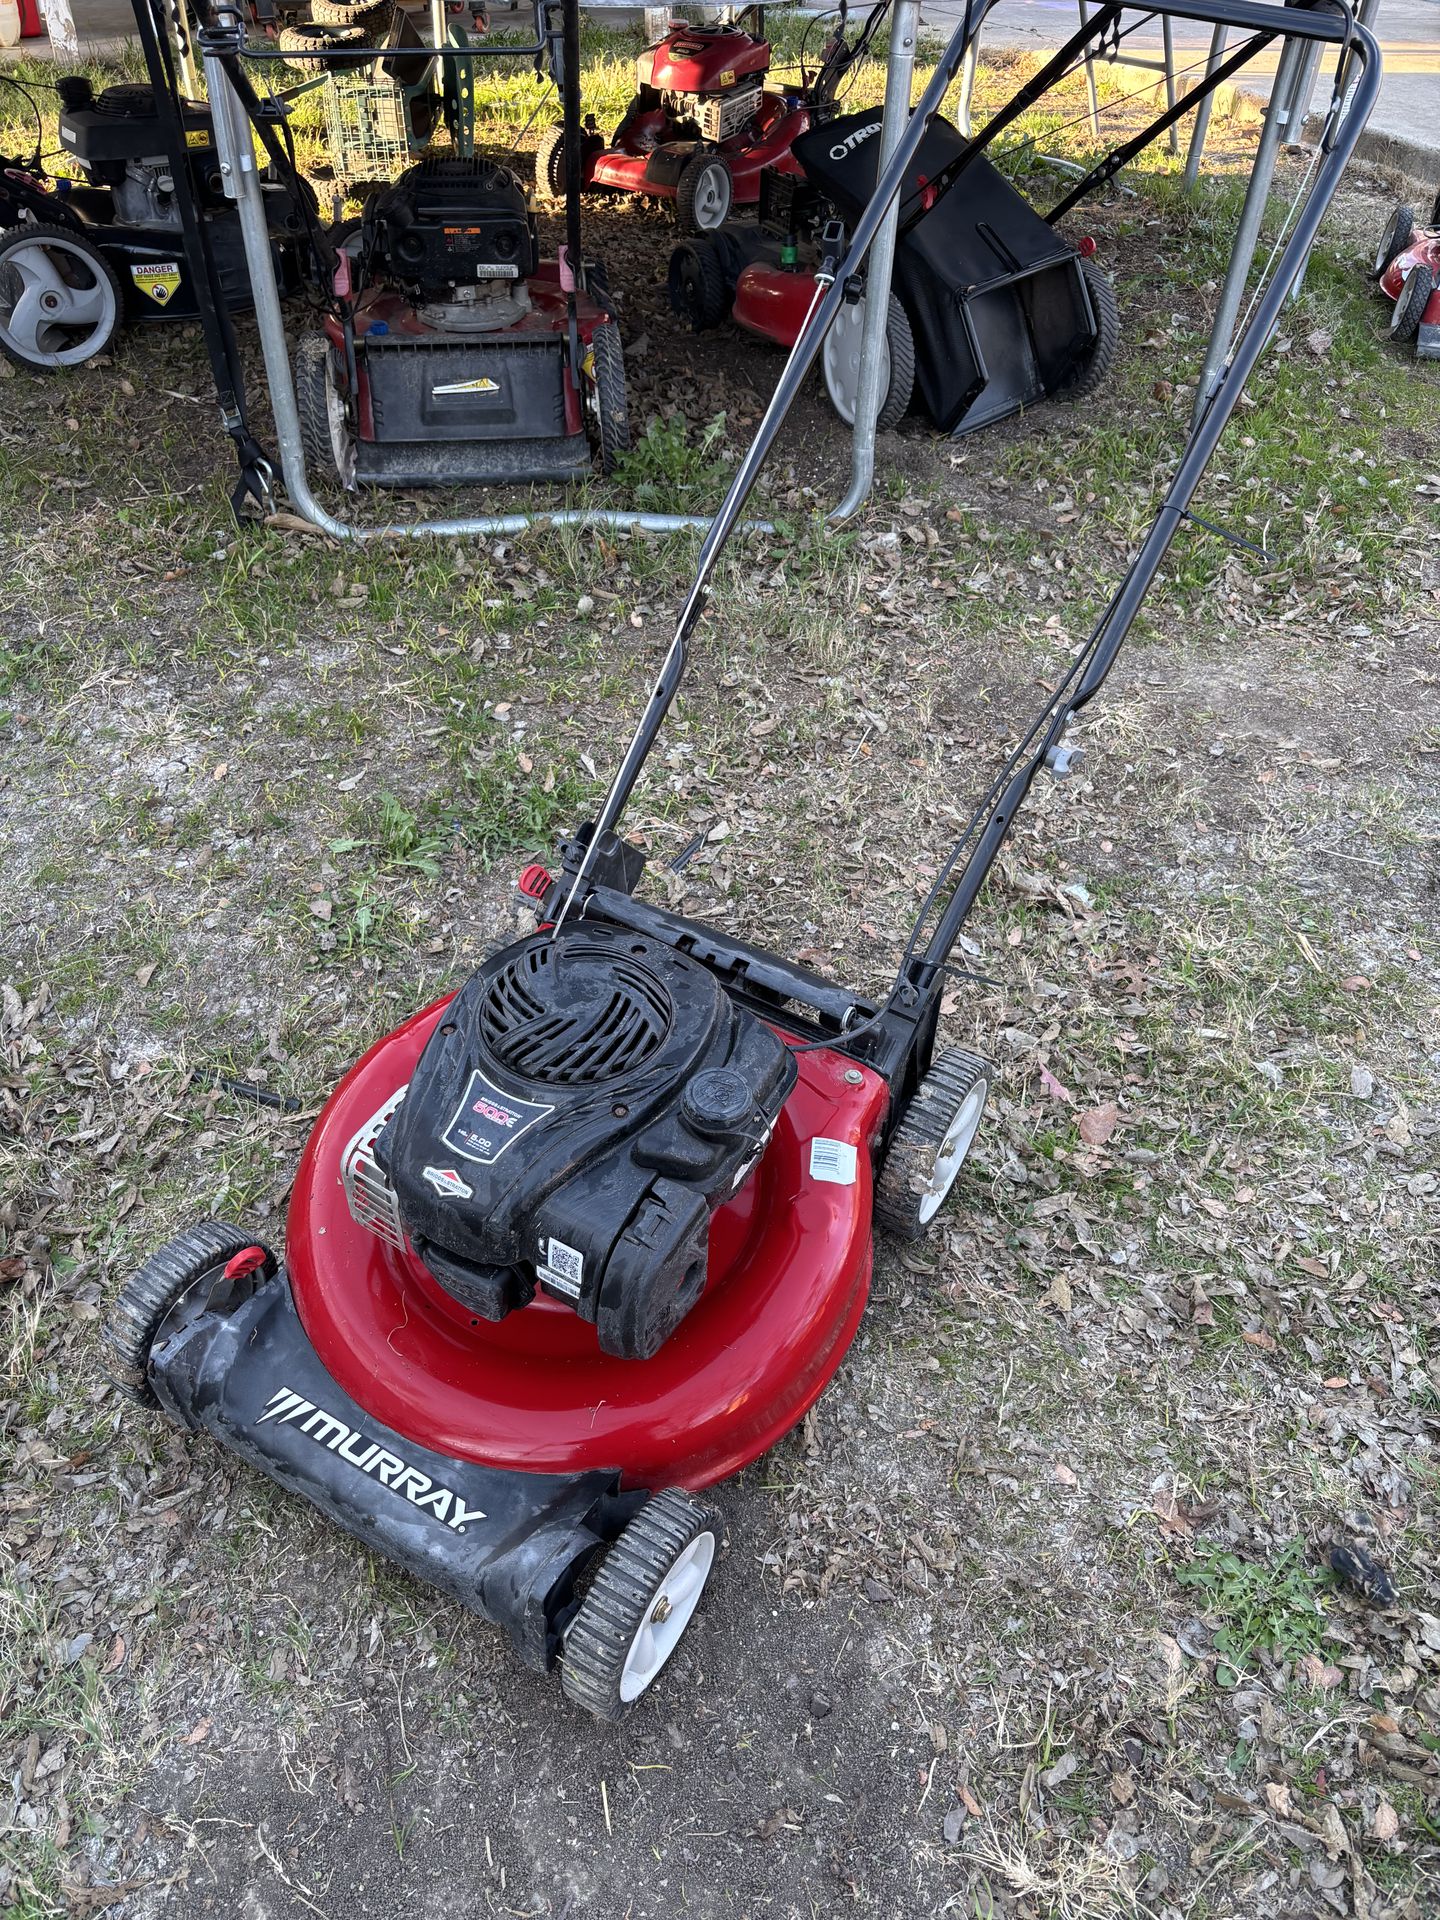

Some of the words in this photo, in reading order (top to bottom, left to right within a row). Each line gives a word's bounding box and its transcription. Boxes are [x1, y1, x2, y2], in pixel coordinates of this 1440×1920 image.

[843, 122, 883, 150] TRO
[136, 265, 174, 274] DANGER
[471, 1134, 492, 1148] 5.00
